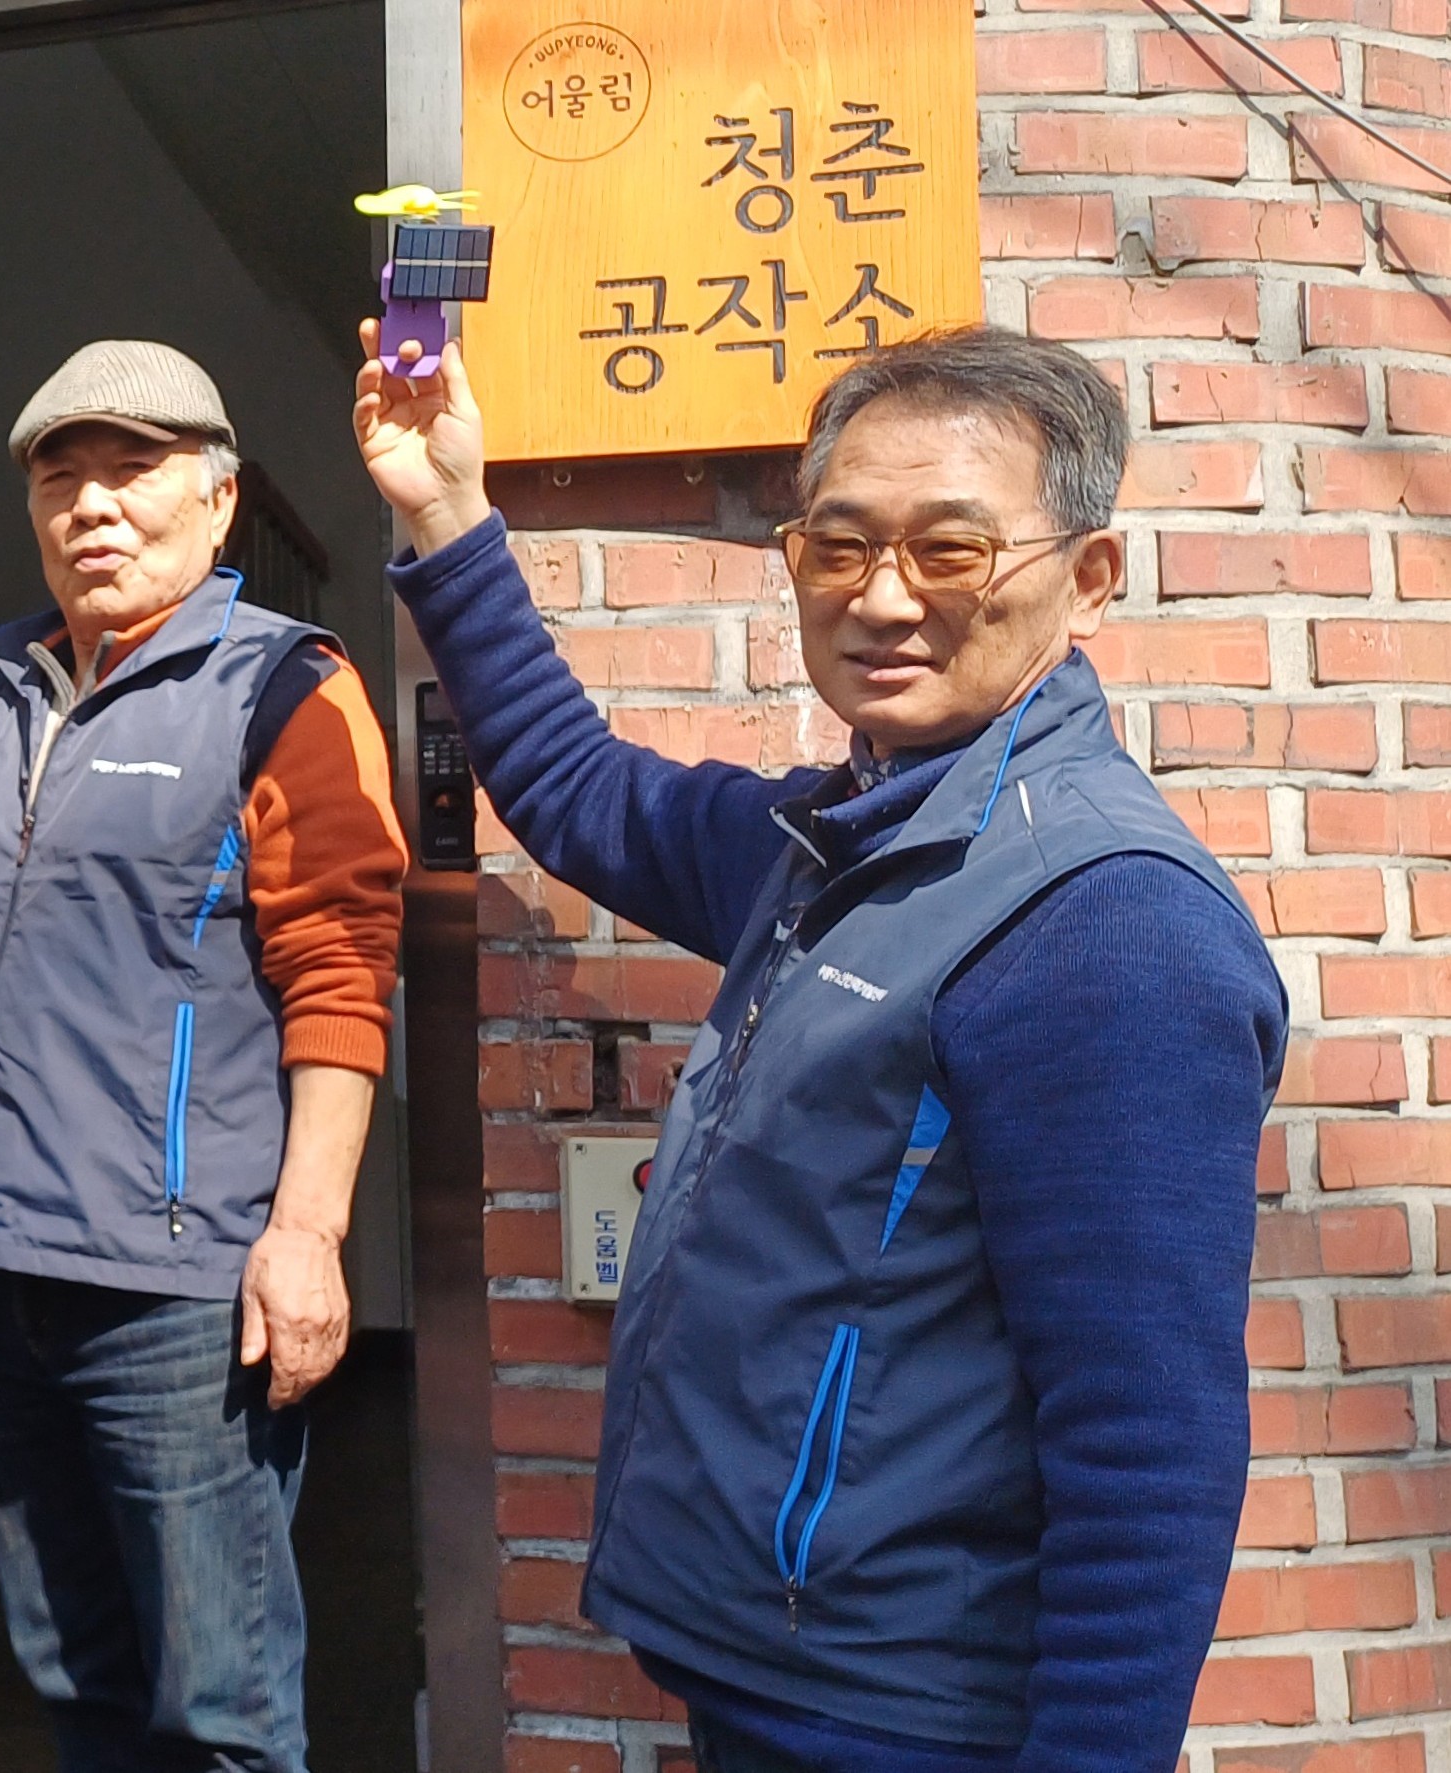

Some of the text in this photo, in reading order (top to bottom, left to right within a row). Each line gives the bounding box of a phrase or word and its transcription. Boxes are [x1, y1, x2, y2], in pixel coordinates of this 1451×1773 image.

[521, 71, 632, 119] 어울림
[700, 101, 925, 234] 청춘
[579, 259, 915, 394] 공작소
